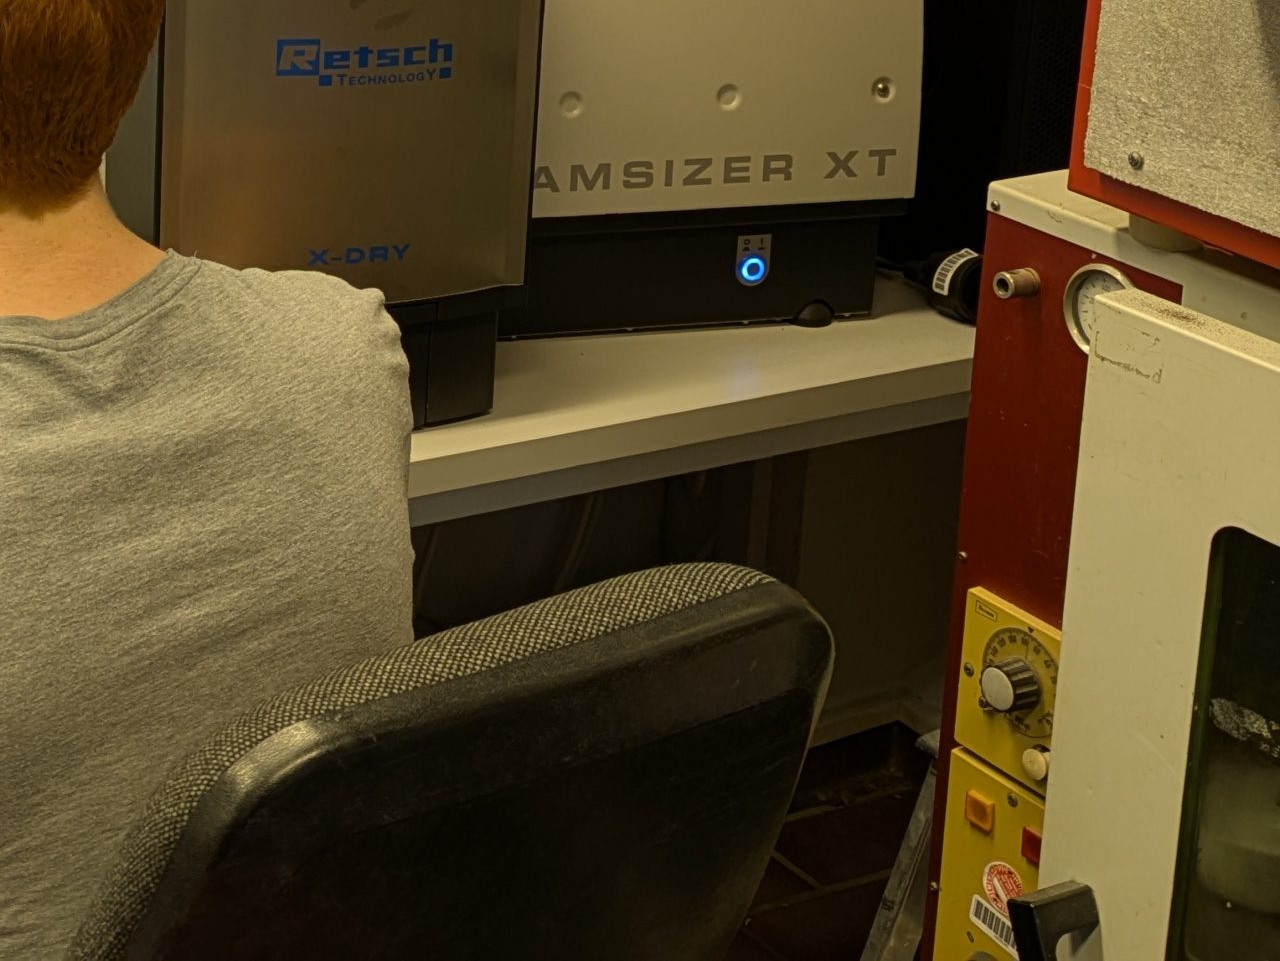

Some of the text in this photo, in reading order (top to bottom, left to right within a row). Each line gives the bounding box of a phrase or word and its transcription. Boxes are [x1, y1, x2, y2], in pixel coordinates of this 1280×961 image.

[276, 38, 453, 77] Retsch
[337, 68, 437, 86] TECHNOLOGY
[824, 149, 897, 180] XT
[308, 243, 411, 266] X-DRY
